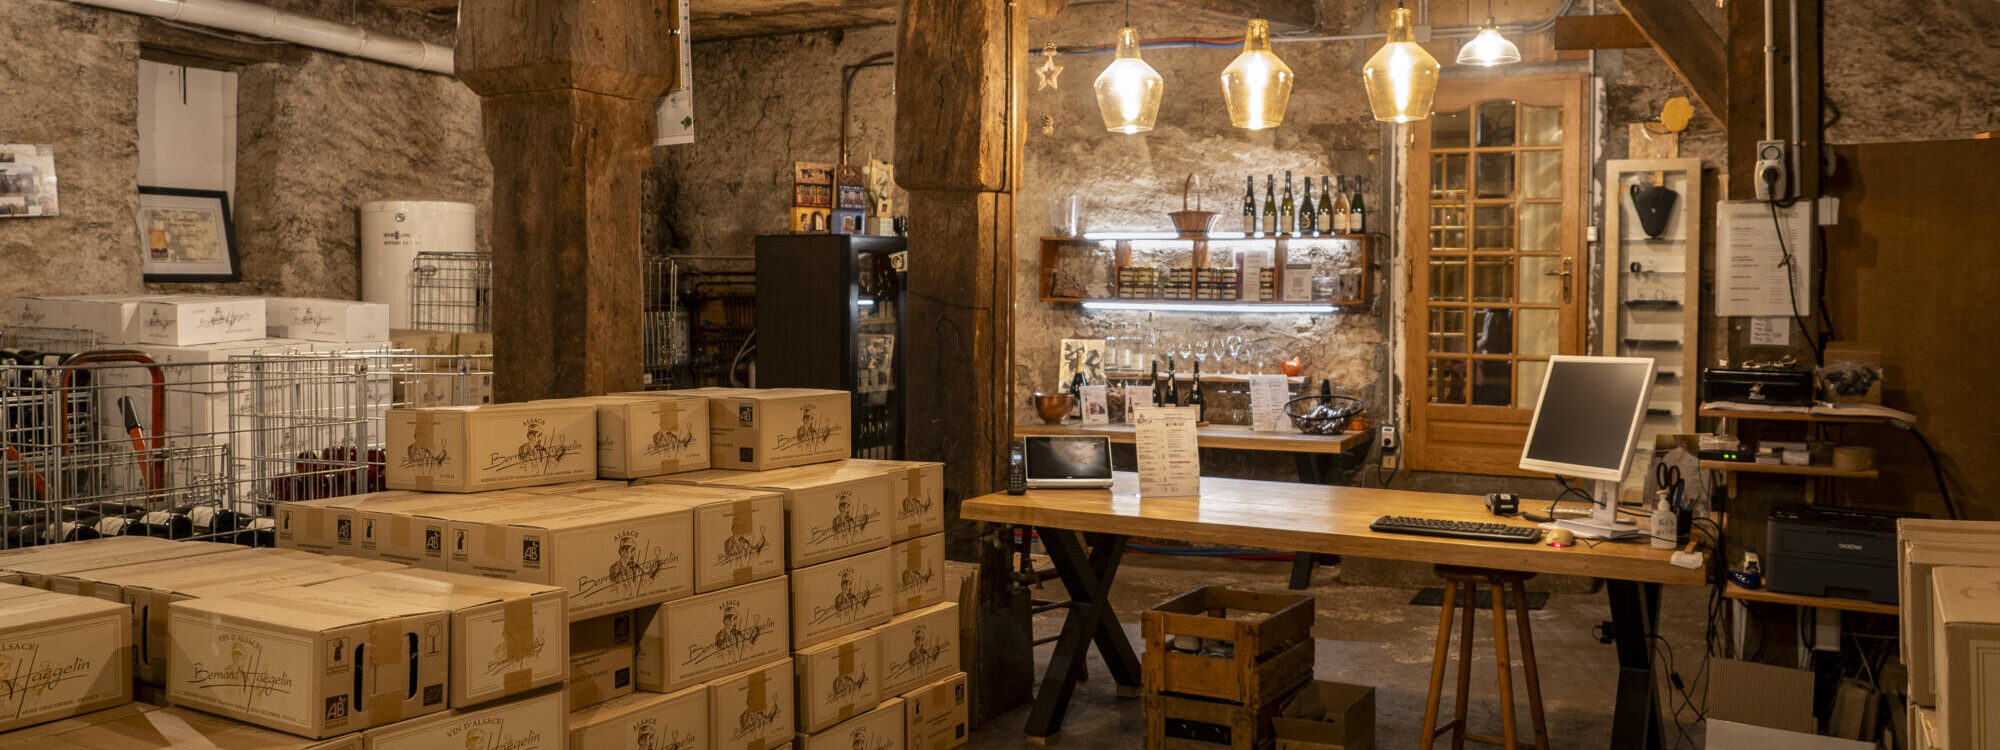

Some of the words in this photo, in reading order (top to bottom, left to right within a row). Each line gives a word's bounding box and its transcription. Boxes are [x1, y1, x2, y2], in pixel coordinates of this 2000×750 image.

[184, 662, 241, 684] Bernard
[240, 644, 292, 714] Haegelin
[446, 726, 462, 738] VIN
[464, 717, 501, 730] D'ALSACE
